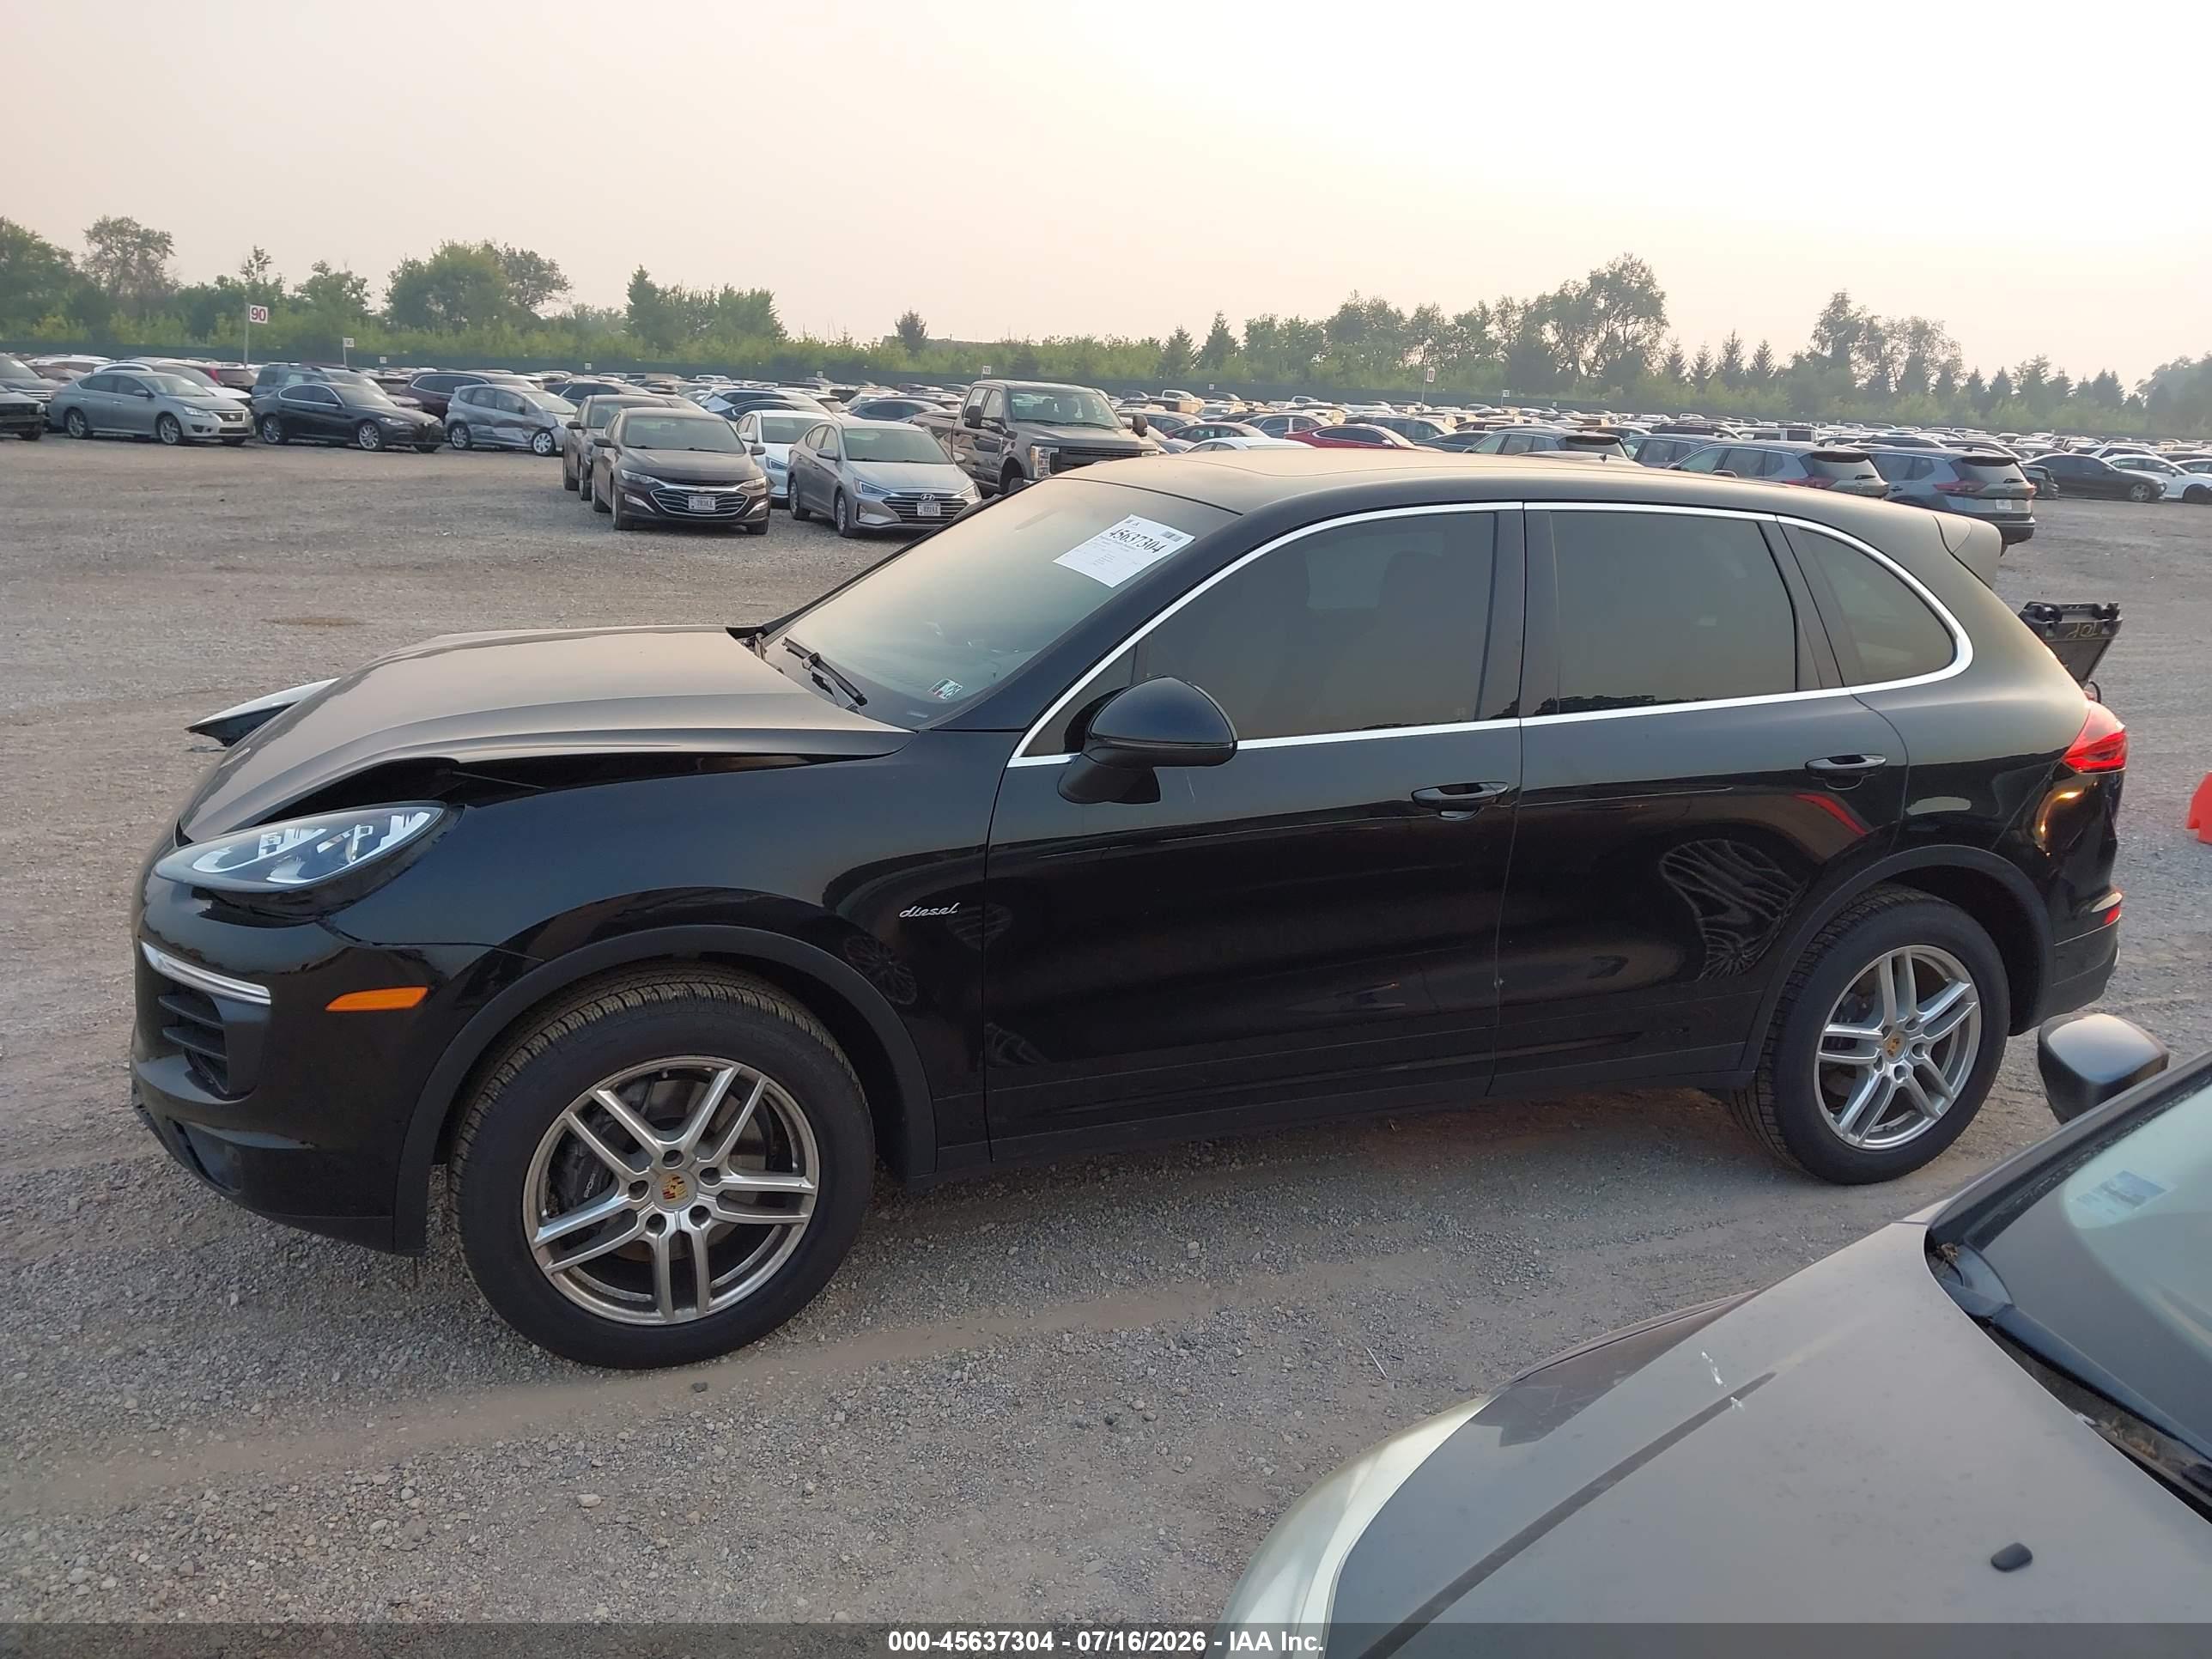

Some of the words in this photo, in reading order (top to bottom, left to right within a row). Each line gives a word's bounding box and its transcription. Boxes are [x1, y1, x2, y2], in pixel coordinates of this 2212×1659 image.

[251, 307, 267, 322] 90
[1109, 528, 1168, 554] 45637304
[899, 902, 961, 918] diesel
